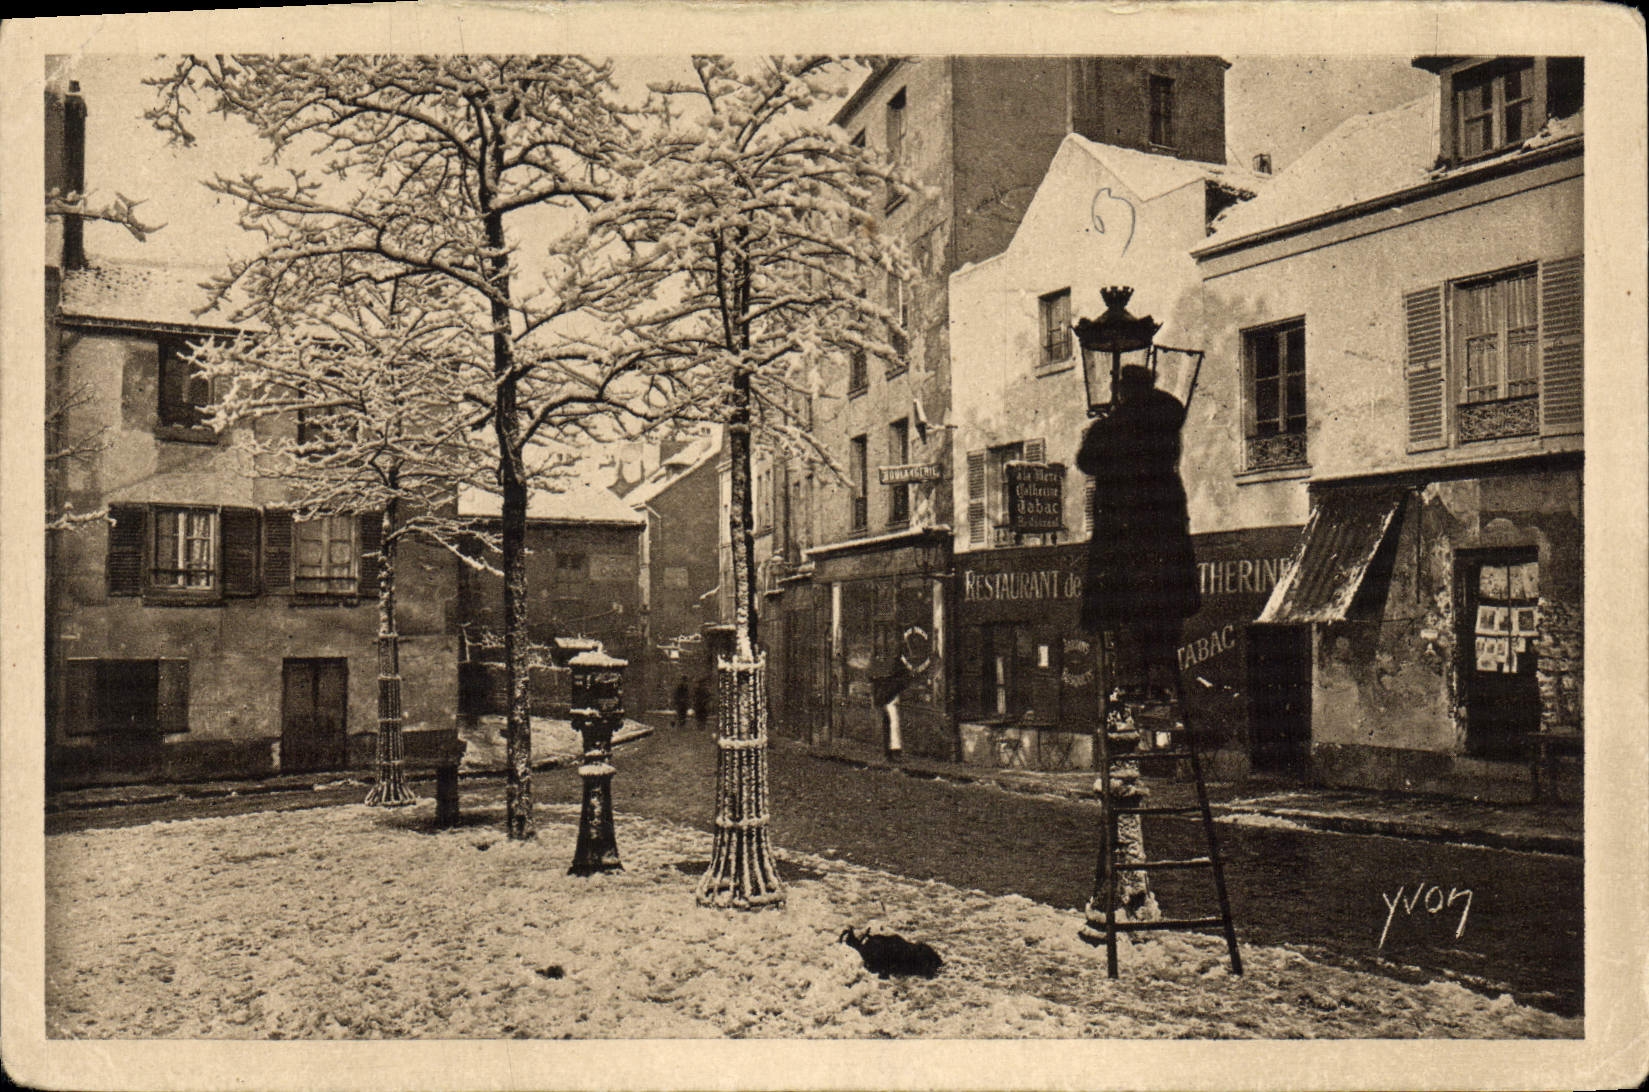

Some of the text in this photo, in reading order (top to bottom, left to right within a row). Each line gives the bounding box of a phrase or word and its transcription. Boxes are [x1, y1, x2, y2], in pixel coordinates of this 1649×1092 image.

[1016, 498, 1060, 515] Tabac
[964, 569, 1060, 601] RESTAURANT
[1196, 557, 1292, 595] THERINE
[1177, 624, 1236, 671] TABAC
